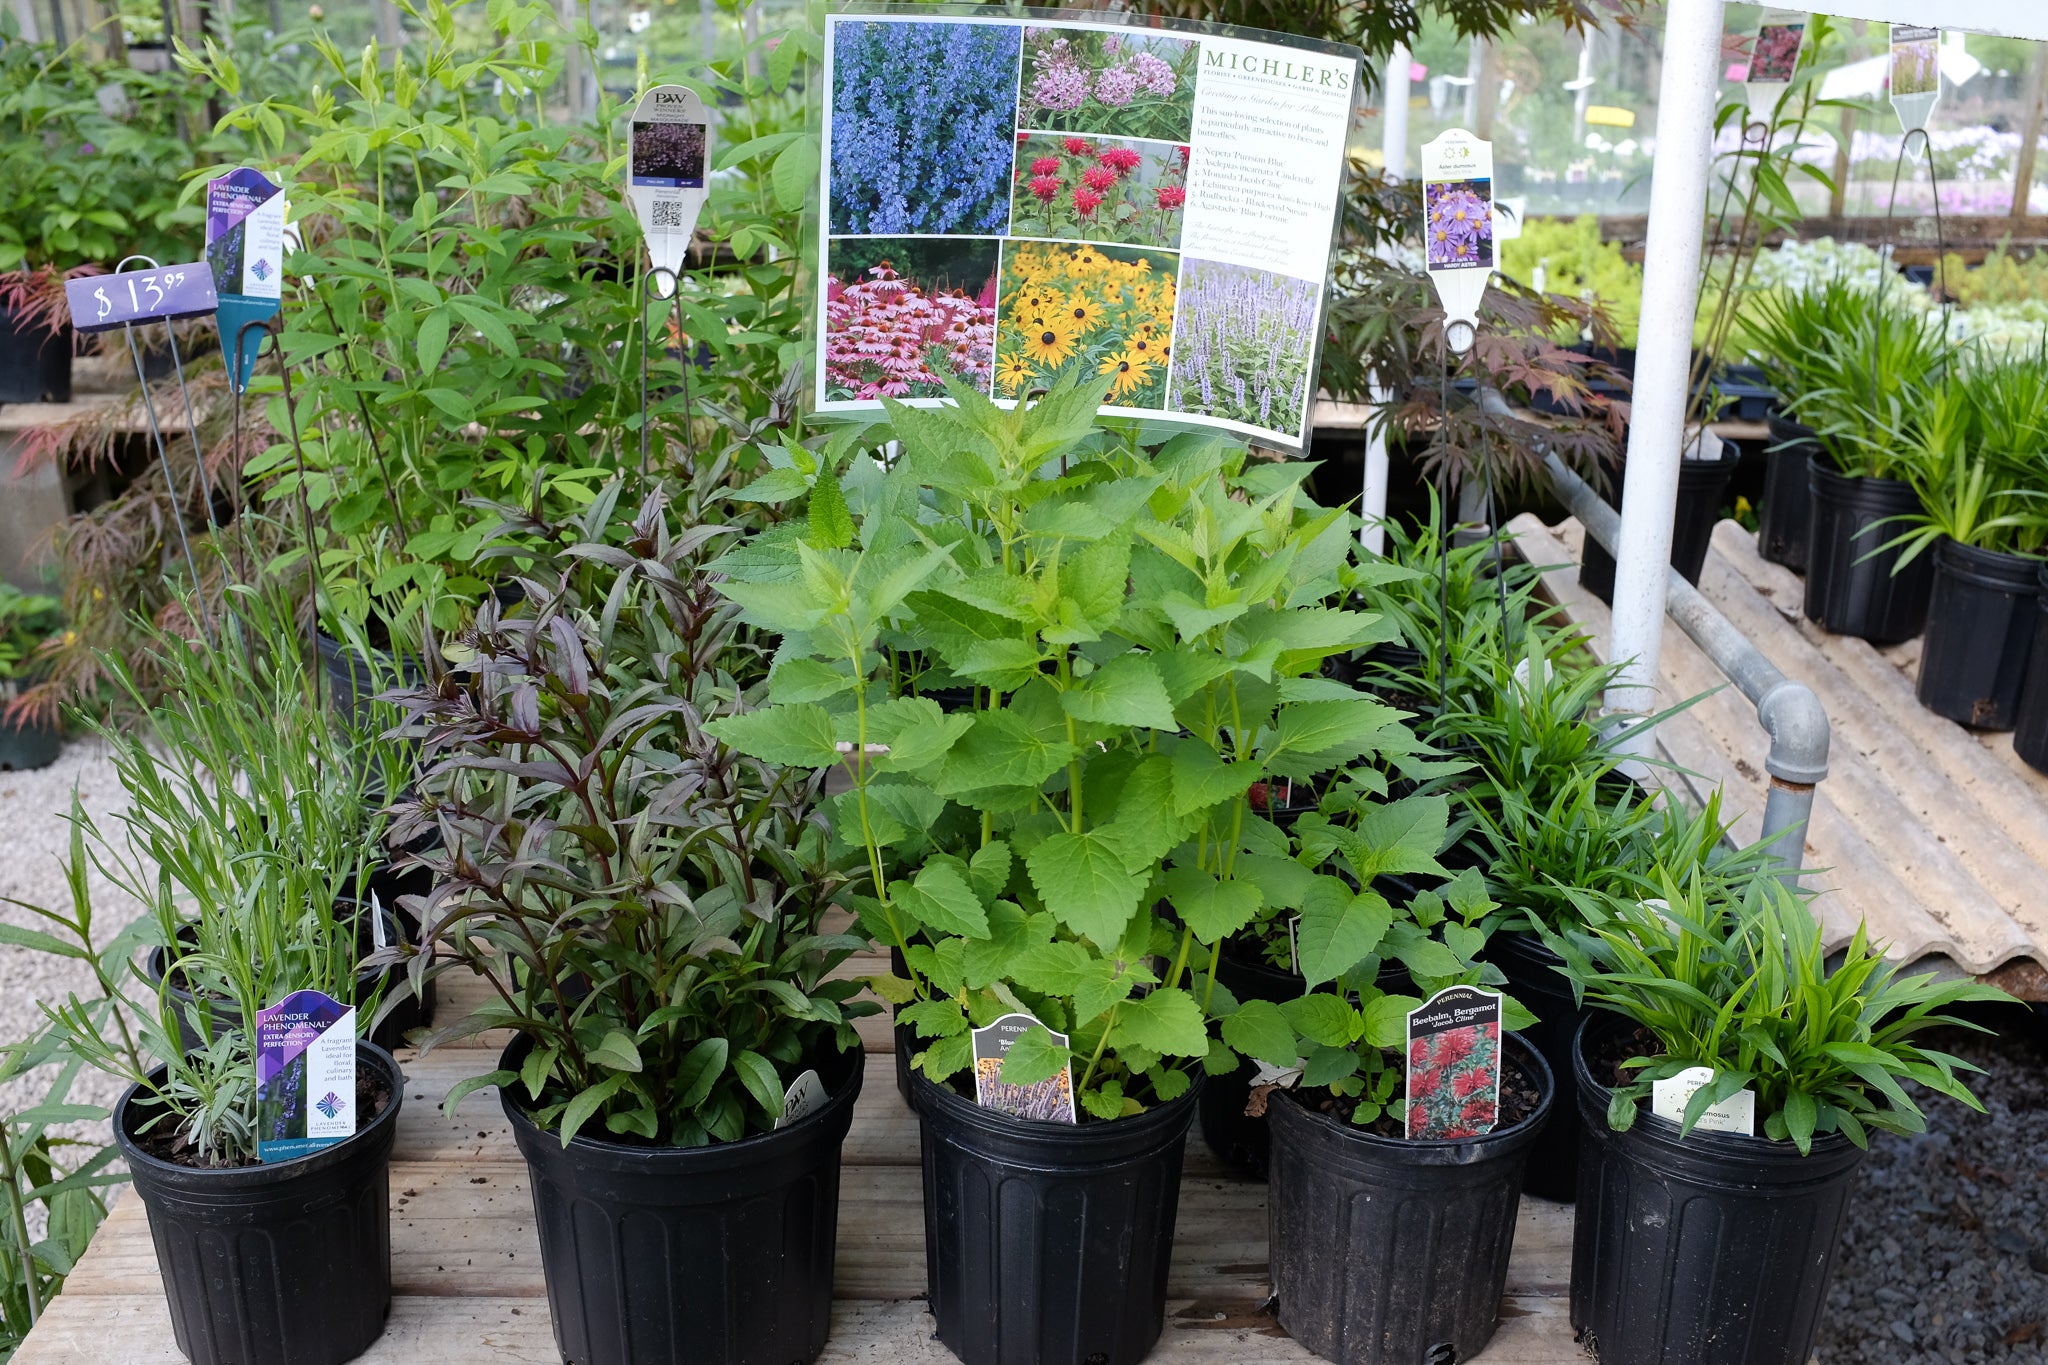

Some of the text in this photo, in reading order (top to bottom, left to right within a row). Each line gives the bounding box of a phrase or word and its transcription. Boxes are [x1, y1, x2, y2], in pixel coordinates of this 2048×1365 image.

[1205, 50, 1349, 90] MICHLER'S
[1200, 105, 1218, 115] This
[1219, 110, 1258, 123] sun-loving
[1259, 115, 1292, 128] selection
[1301, 124, 1324, 134] plants
[1208, 120, 1250, 132] particularly
[1252, 127, 1286, 138] attractive
[1315, 139, 1329, 147] and
[1203, 146, 1231, 158] Nepeta
[213, 184, 250, 194] LAVENDER
[93, 286, 112, 321] $
[1436, 992, 1473, 1006] PERENNIAL
[263, 1012, 309, 1022] LAVENDER
[1412, 1003, 1496, 1027] Beebalm, Bergamot
[1431, 1018, 1454, 1028] 'Jacob
[1001, 1025, 1028, 1033] PERENN
[263, 1032, 315, 1041] EXTRA SENSORY
[326, 1067, 353, 1075] culinary
[1702, 1110, 1730, 1119] umosus
